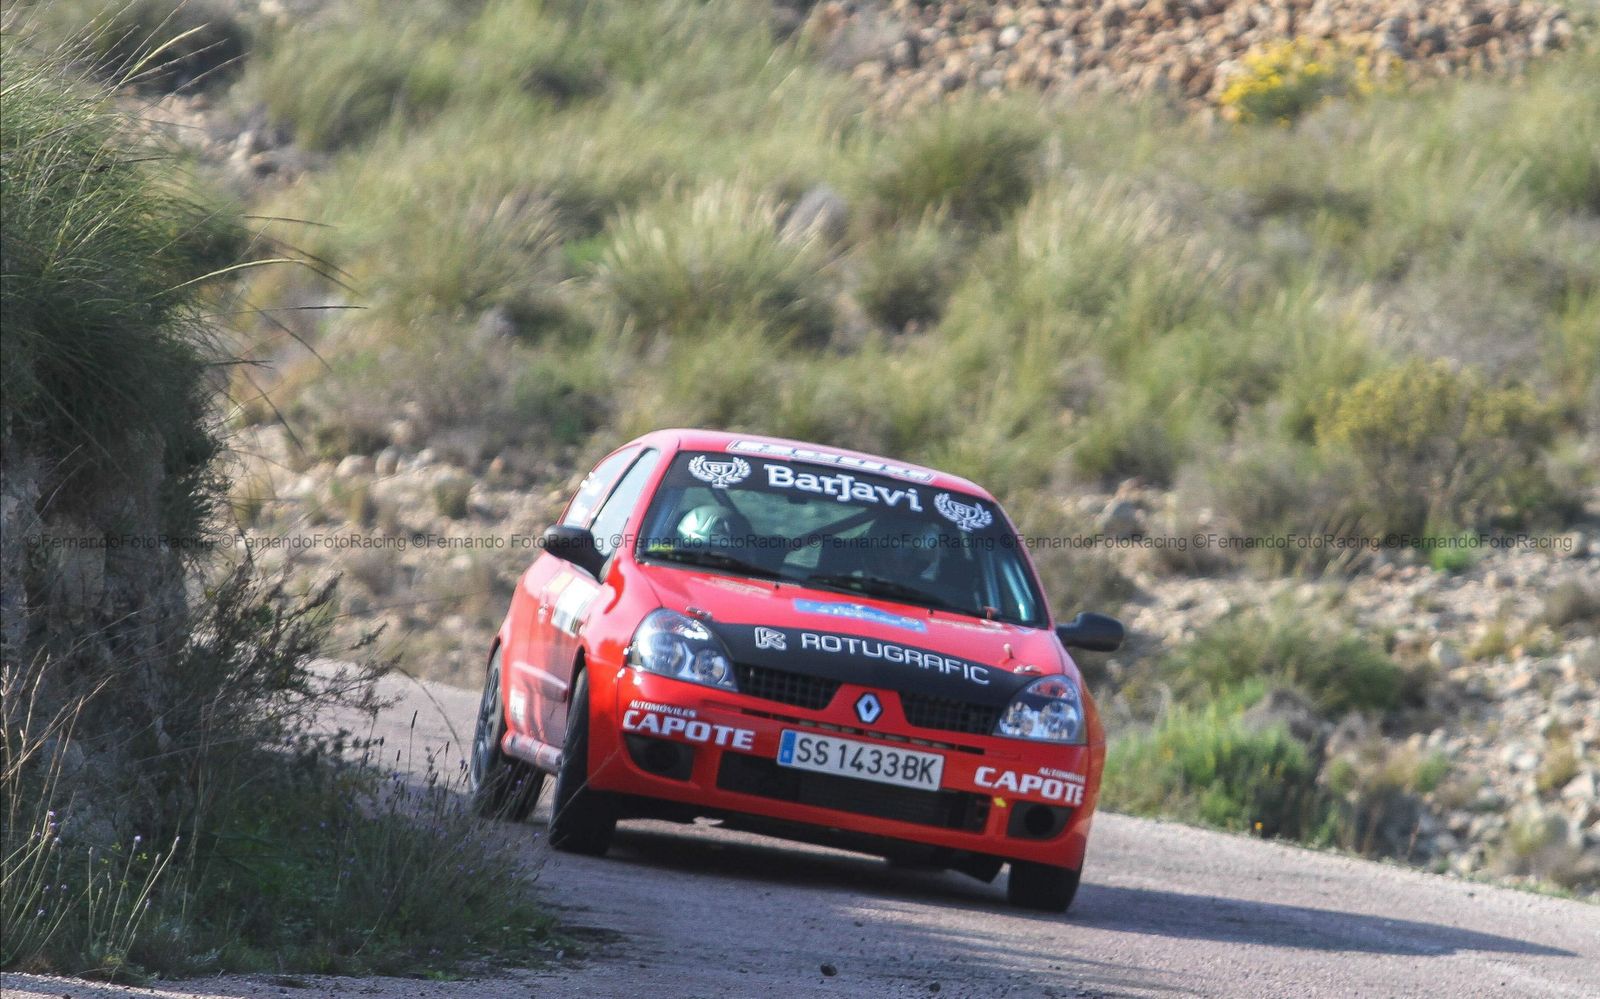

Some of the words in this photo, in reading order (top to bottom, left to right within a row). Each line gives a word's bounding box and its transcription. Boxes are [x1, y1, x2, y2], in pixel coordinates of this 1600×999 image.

[764, 464, 923, 512] BarJavi
[801, 633, 990, 685] ROTUGRAFIC
[622, 709, 755, 750] CAPOTE
[797, 738, 829, 765] SS
[974, 766, 1084, 806] CAPOTE
